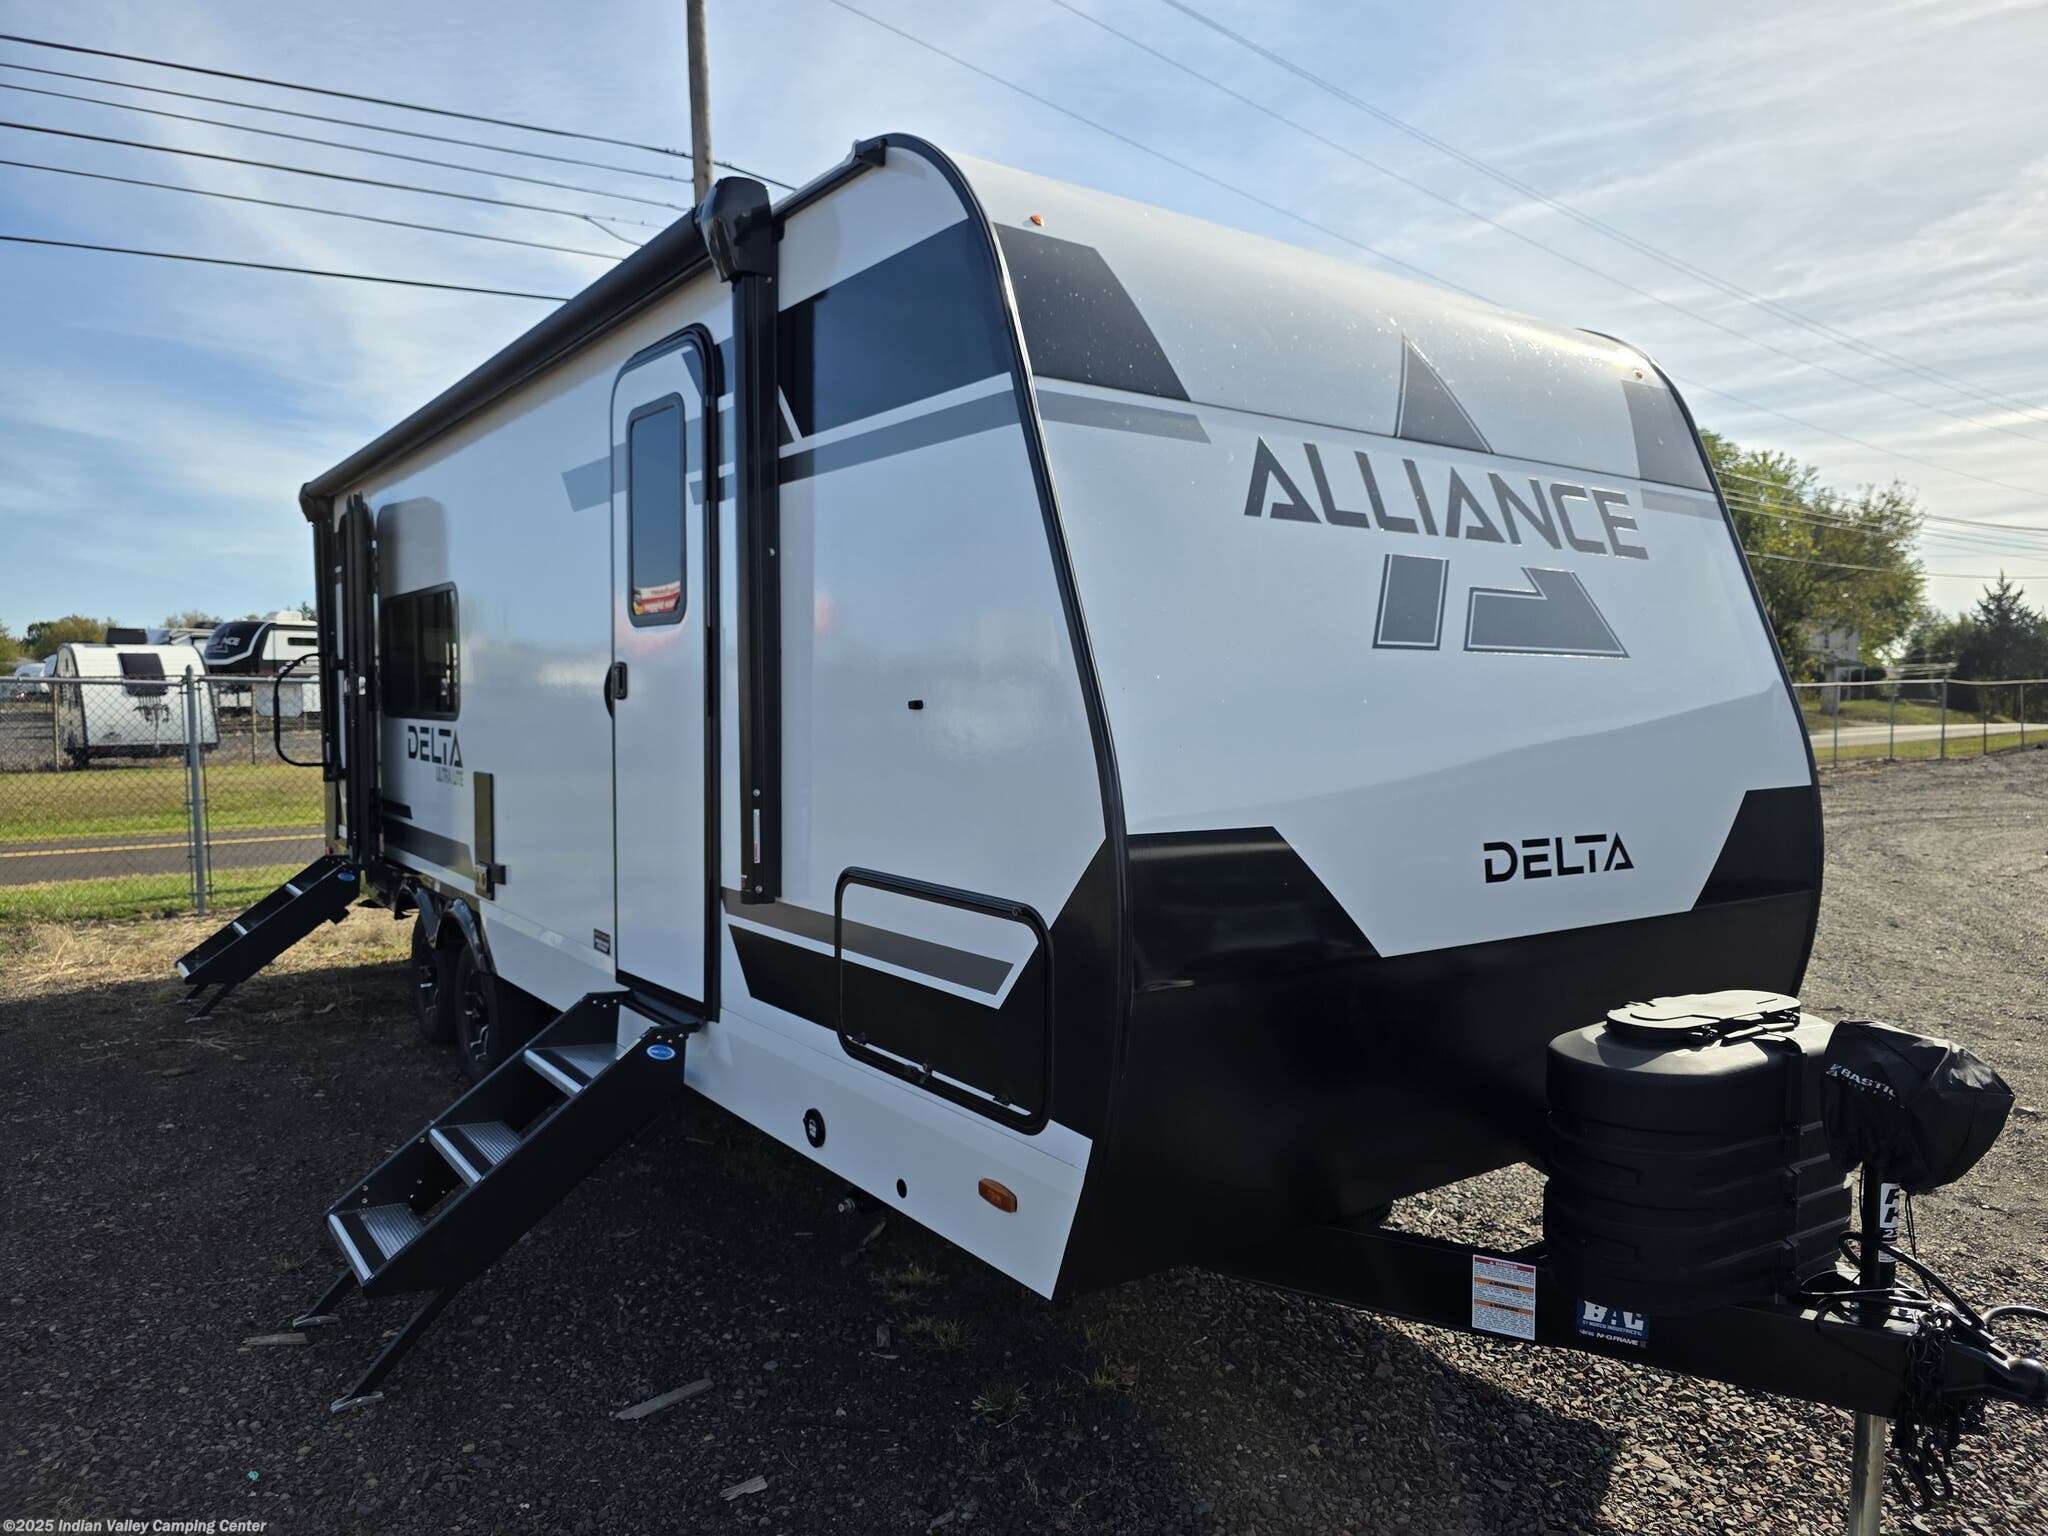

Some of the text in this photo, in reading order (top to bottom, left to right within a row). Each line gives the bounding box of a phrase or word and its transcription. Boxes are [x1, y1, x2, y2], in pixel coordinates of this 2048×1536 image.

[1244, 435, 1650, 560] ALLIANCE
[408, 725, 463, 768] DELTA
[1483, 832, 1634, 883] DELTA
